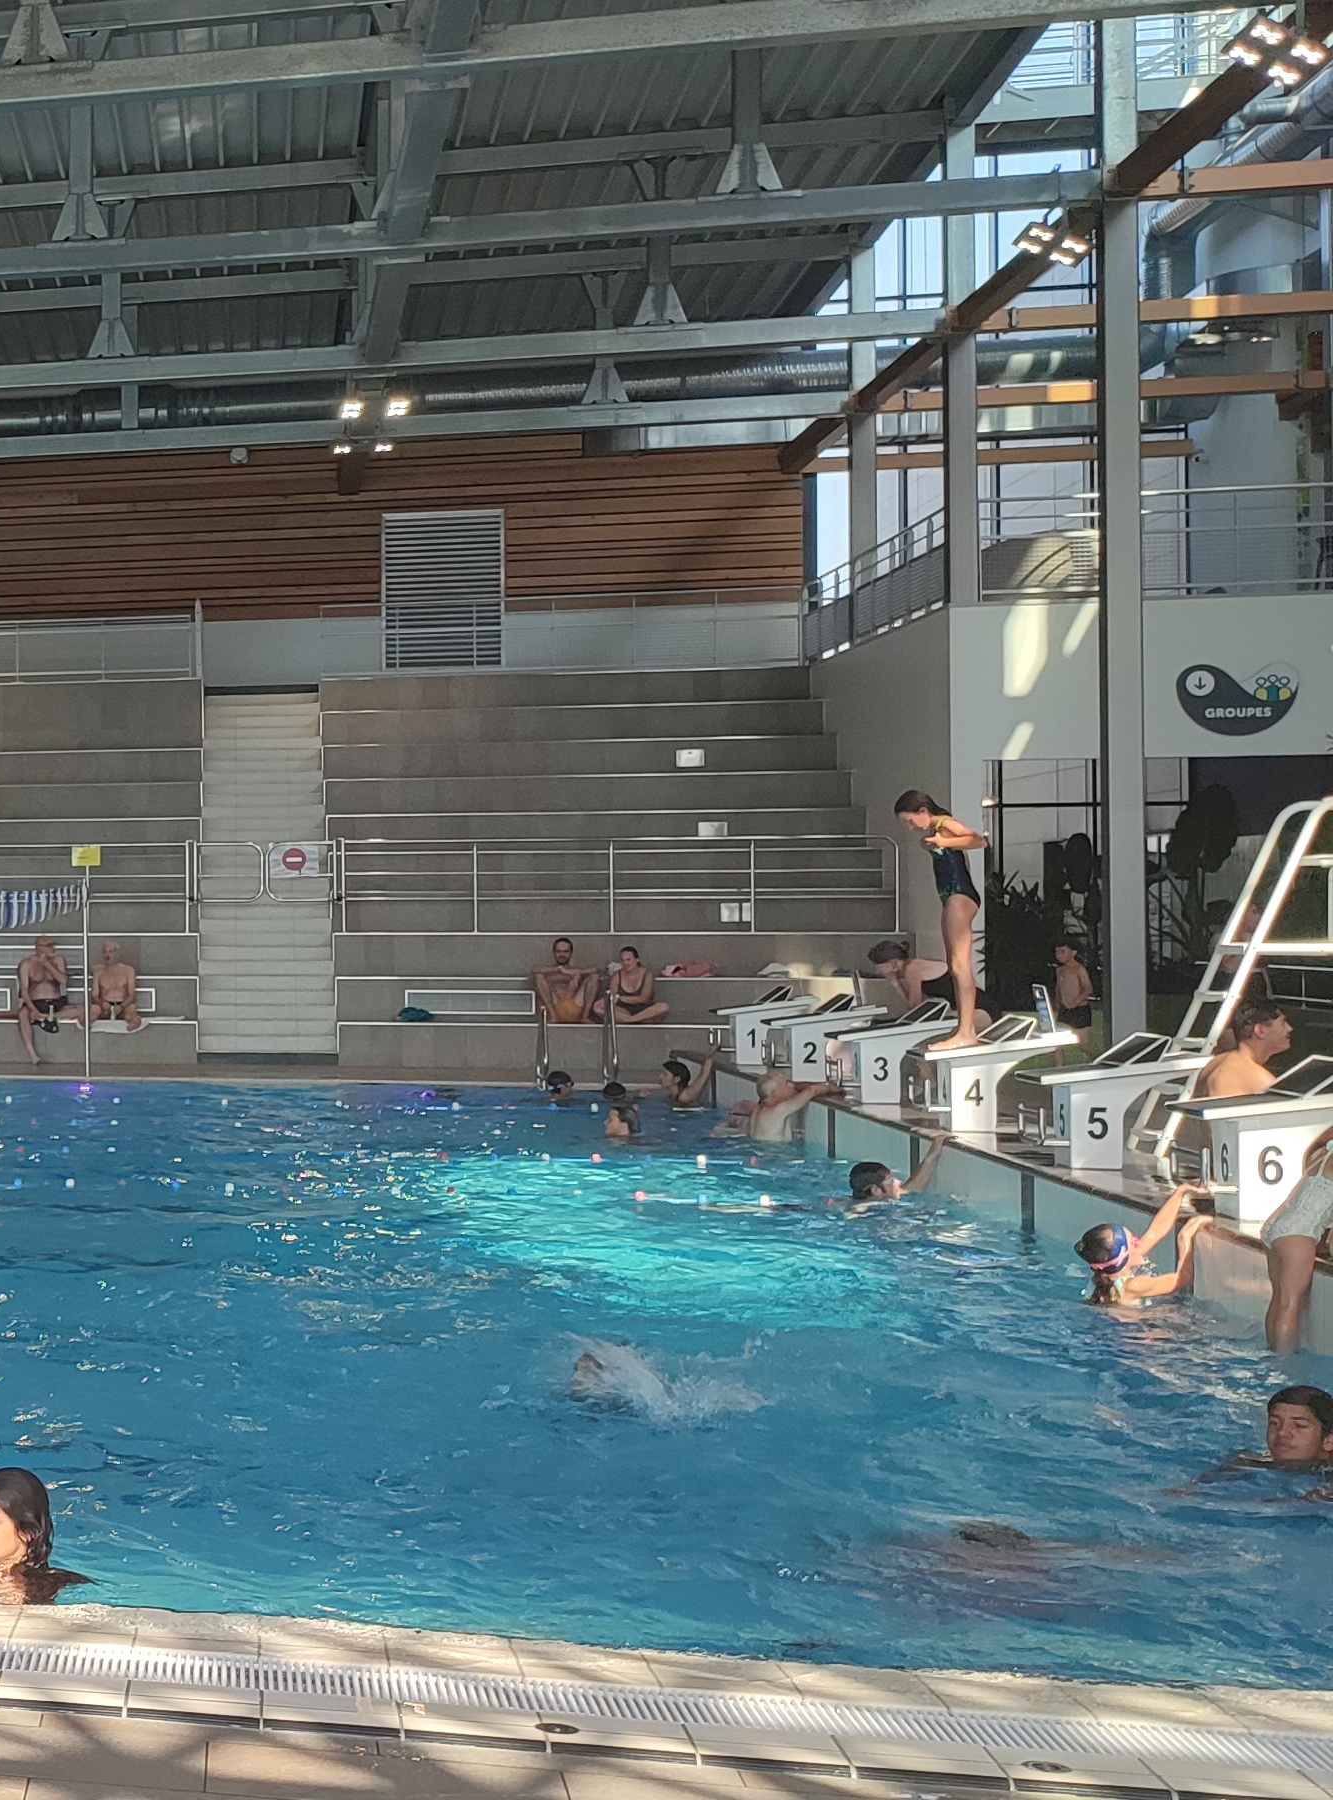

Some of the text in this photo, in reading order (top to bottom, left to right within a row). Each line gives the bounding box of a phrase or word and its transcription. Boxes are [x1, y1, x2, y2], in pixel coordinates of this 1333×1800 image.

[1204, 706, 1272, 719] GROUPES
[747, 1028, 755, 1048] 1
[803, 1042, 817, 1064] 2
[873, 1056, 888, 1081] 3
[964, 1078, 984, 1107] 4
[1087, 1107, 1109, 1139] 5
[1220, 1143, 1229, 1182] 6
[1258, 1145, 1284, 1186] 6
